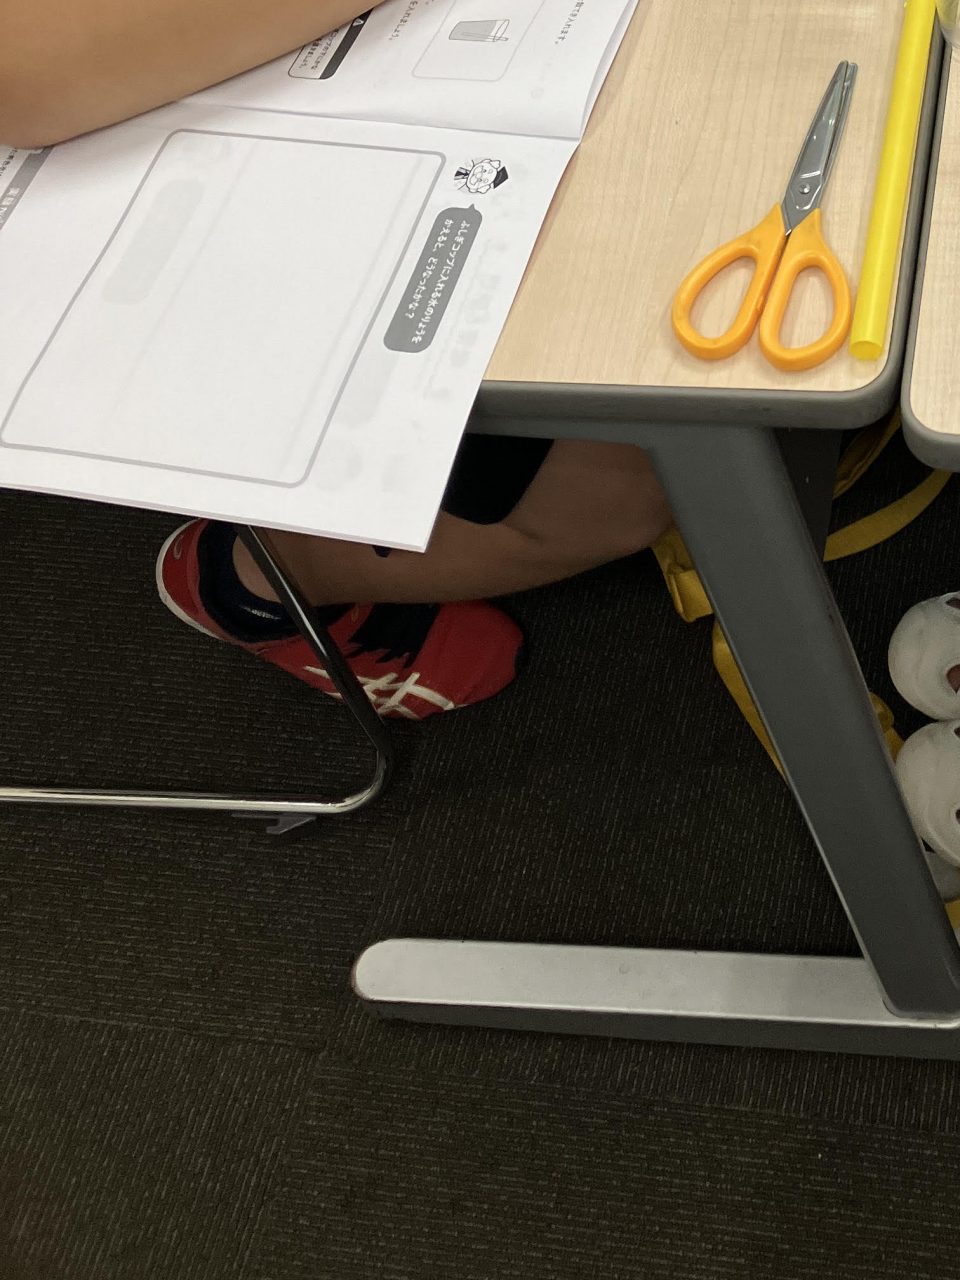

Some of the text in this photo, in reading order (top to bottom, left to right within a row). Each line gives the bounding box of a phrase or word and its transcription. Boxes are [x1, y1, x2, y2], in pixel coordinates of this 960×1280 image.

[411, 220, 471, 345] ふしぎコップに入れる水のりょうを
